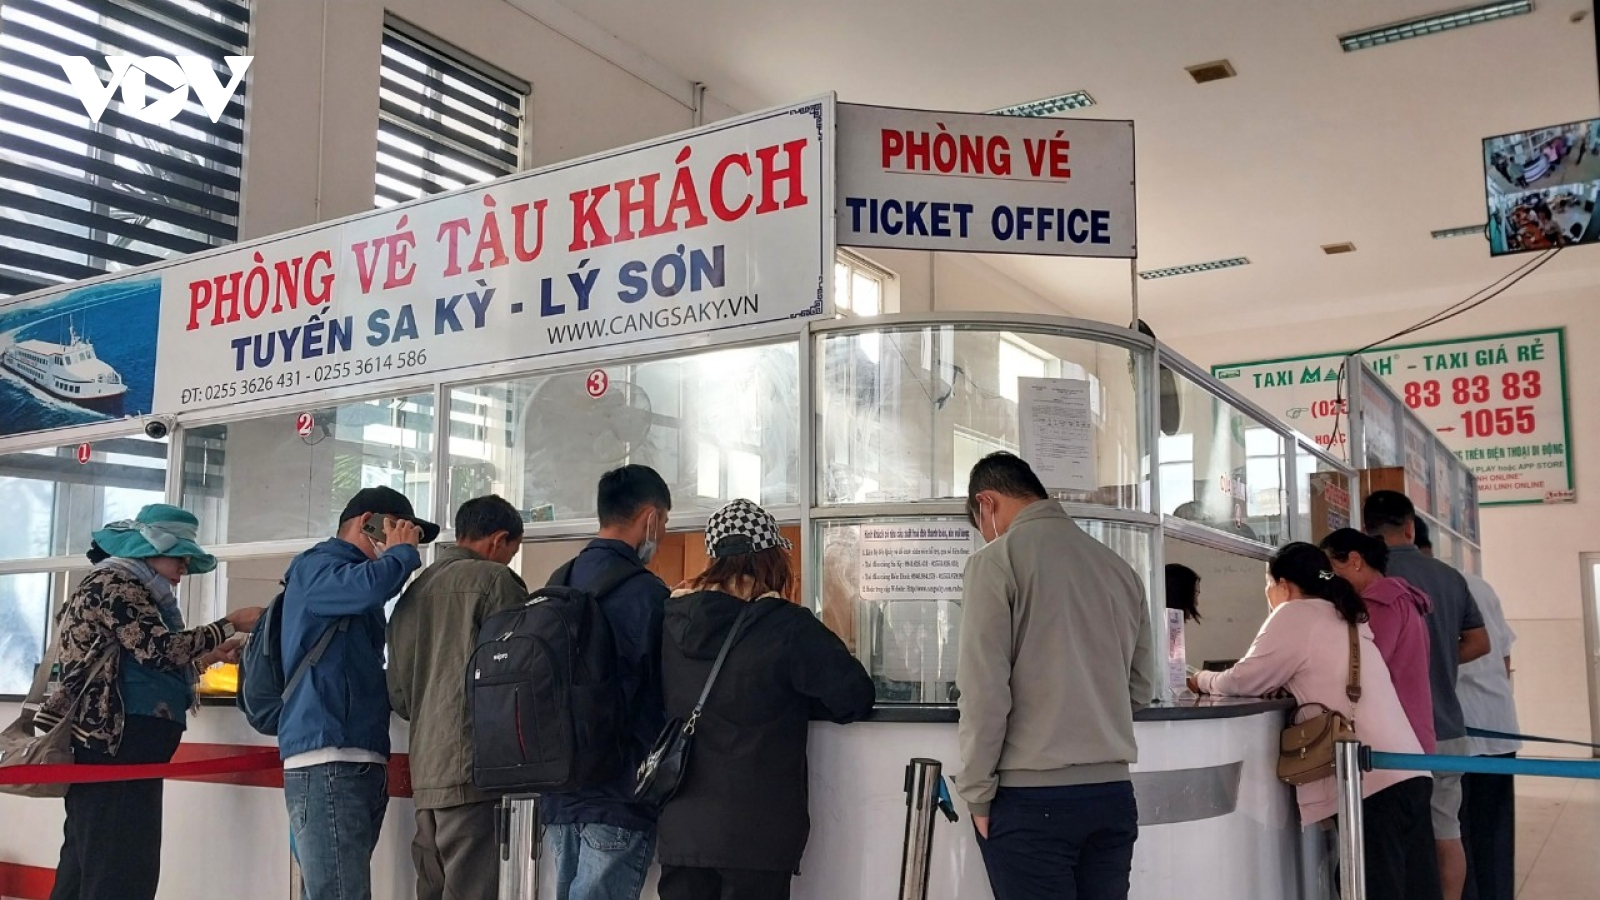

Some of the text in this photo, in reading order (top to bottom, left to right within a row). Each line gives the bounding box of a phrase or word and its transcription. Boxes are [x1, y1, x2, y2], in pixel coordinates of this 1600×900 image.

[881, 122, 1071, 179] PHÒNG VÉ
[186, 138, 809, 332] PHÒNG VÉ TÀU KHÁCH
[845, 197, 1111, 244] TICKET OFFICE
[231, 306, 353, 371] TUYẾN
[366, 304, 419, 347] SA
[434, 279, 496, 336] KỲ
[540, 259, 600, 317] LÝ
[617, 244, 725, 303] SƠN
[547, 294, 759, 345] WWW.CANGSAKY.VN
[181, 386, 202, 405] ĐT:
[204, 381, 237, 401] 0255
[239, 375, 273, 395] 3626
[276, 371, 301, 390] 431
[314, 361, 351, 383] 0255
[354, 355, 393, 376] 3614
[396, 348, 428, 370] 586
[1253, 369, 1294, 389] TAXI
[1300, 364, 1346, 385] MA
[1423, 351, 1469, 371] TAXI
[1475, 344, 1508, 367] GIÁ
[1517, 337, 1545, 362] RẺ
[1404, 379, 1441, 409] 83
[1452, 374, 1491, 405] 83
[1501, 369, 1541, 401] 83
[1460, 405, 1536, 438] 1055
